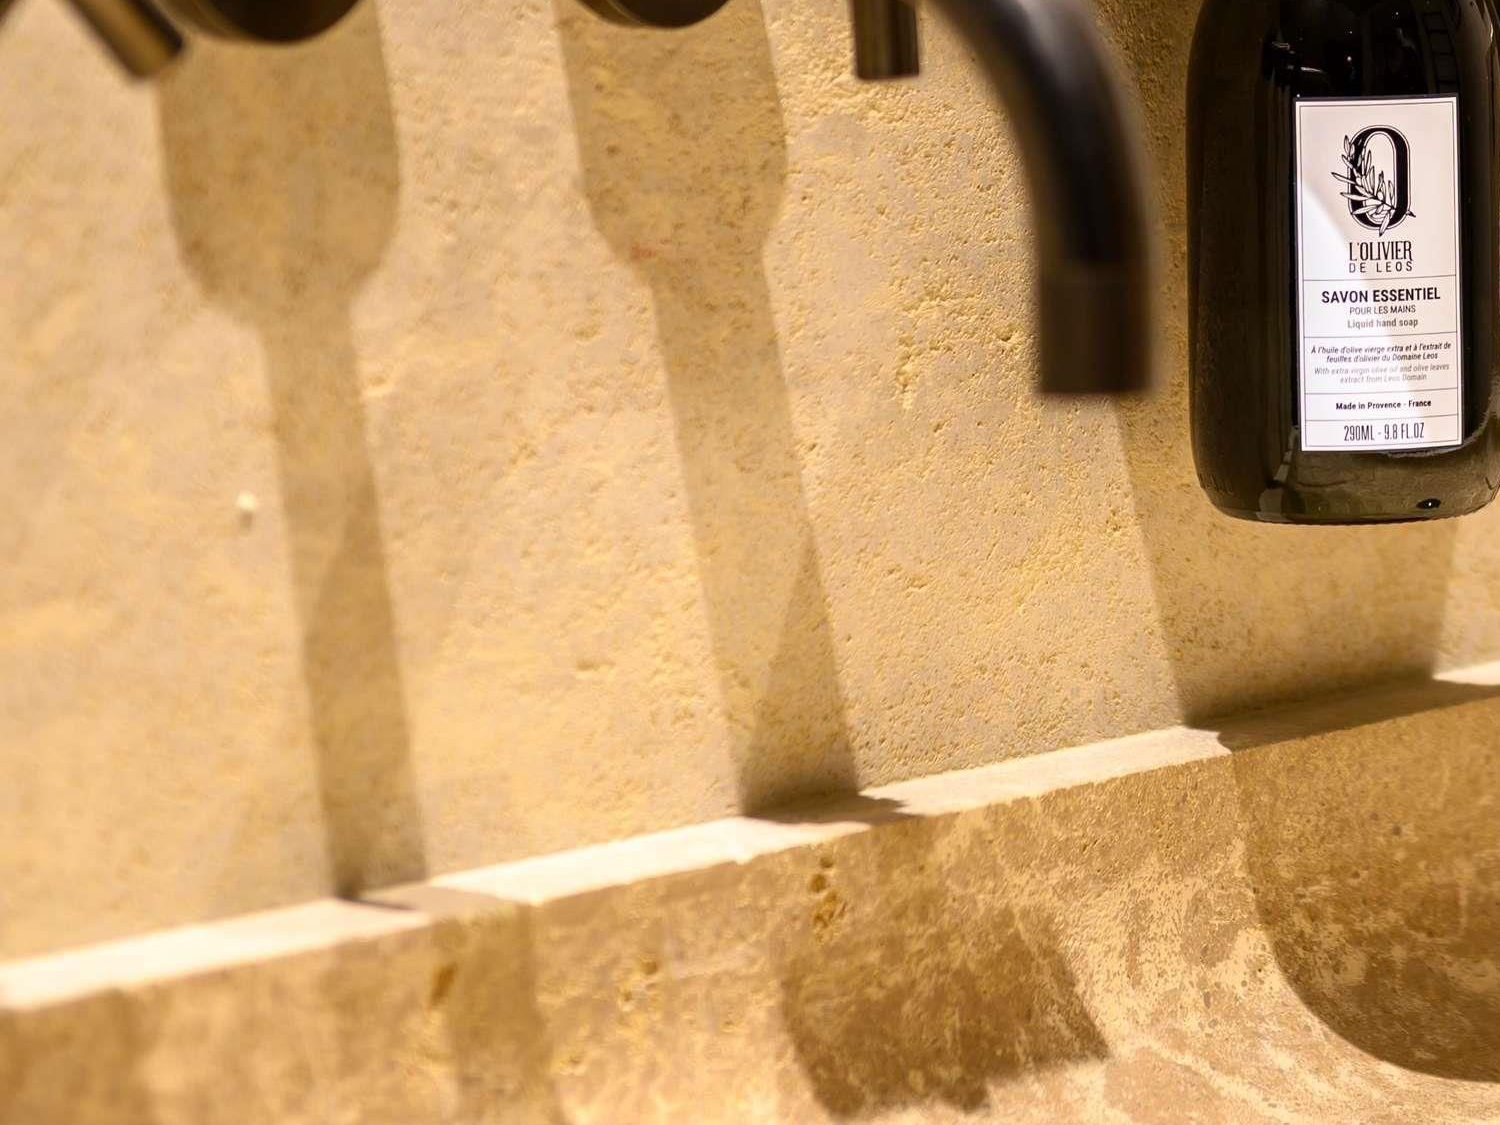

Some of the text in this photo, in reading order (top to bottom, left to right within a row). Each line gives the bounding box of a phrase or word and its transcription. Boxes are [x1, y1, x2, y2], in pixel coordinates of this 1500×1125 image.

[1349, 241, 1413, 261] L'OLIVIER
[1349, 261, 1412, 273] DE LEOS
[1322, 287, 1440, 303] SAVON ESSENTIEL
[1350, 305, 1416, 315] POUR LES MAINS
[1347, 319, 1418, 330] Liquid hand soap
[1368, 401, 1400, 409] Provence
[1344, 425, 1374, 441] 290ML
[1384, 424, 1397, 440] 9.8
